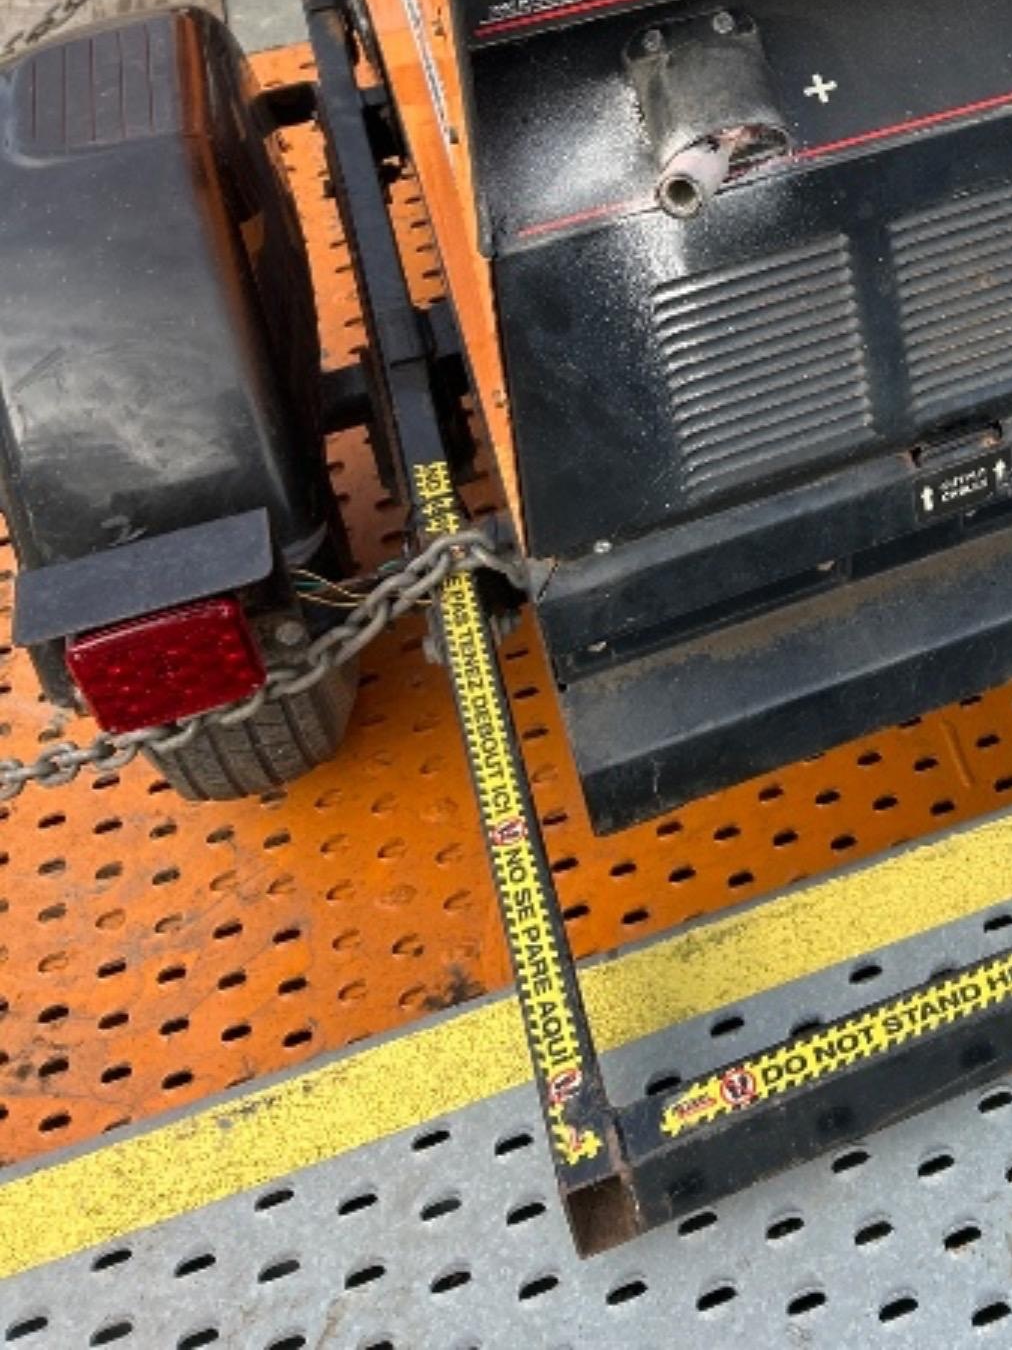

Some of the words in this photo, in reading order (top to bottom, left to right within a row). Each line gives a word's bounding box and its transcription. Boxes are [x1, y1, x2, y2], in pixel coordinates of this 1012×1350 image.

[458, 628, 484, 687] TENEZ
[473, 693, 505, 779] DEBOUT
[504, 849, 527, 885] NO
[514, 888, 535, 922] SE
[521, 925, 552, 994] PARE
[761, 1056, 808, 1085] DO
[812, 1026, 875, 1060] NOT
[881, 983, 983, 1034] STAND
